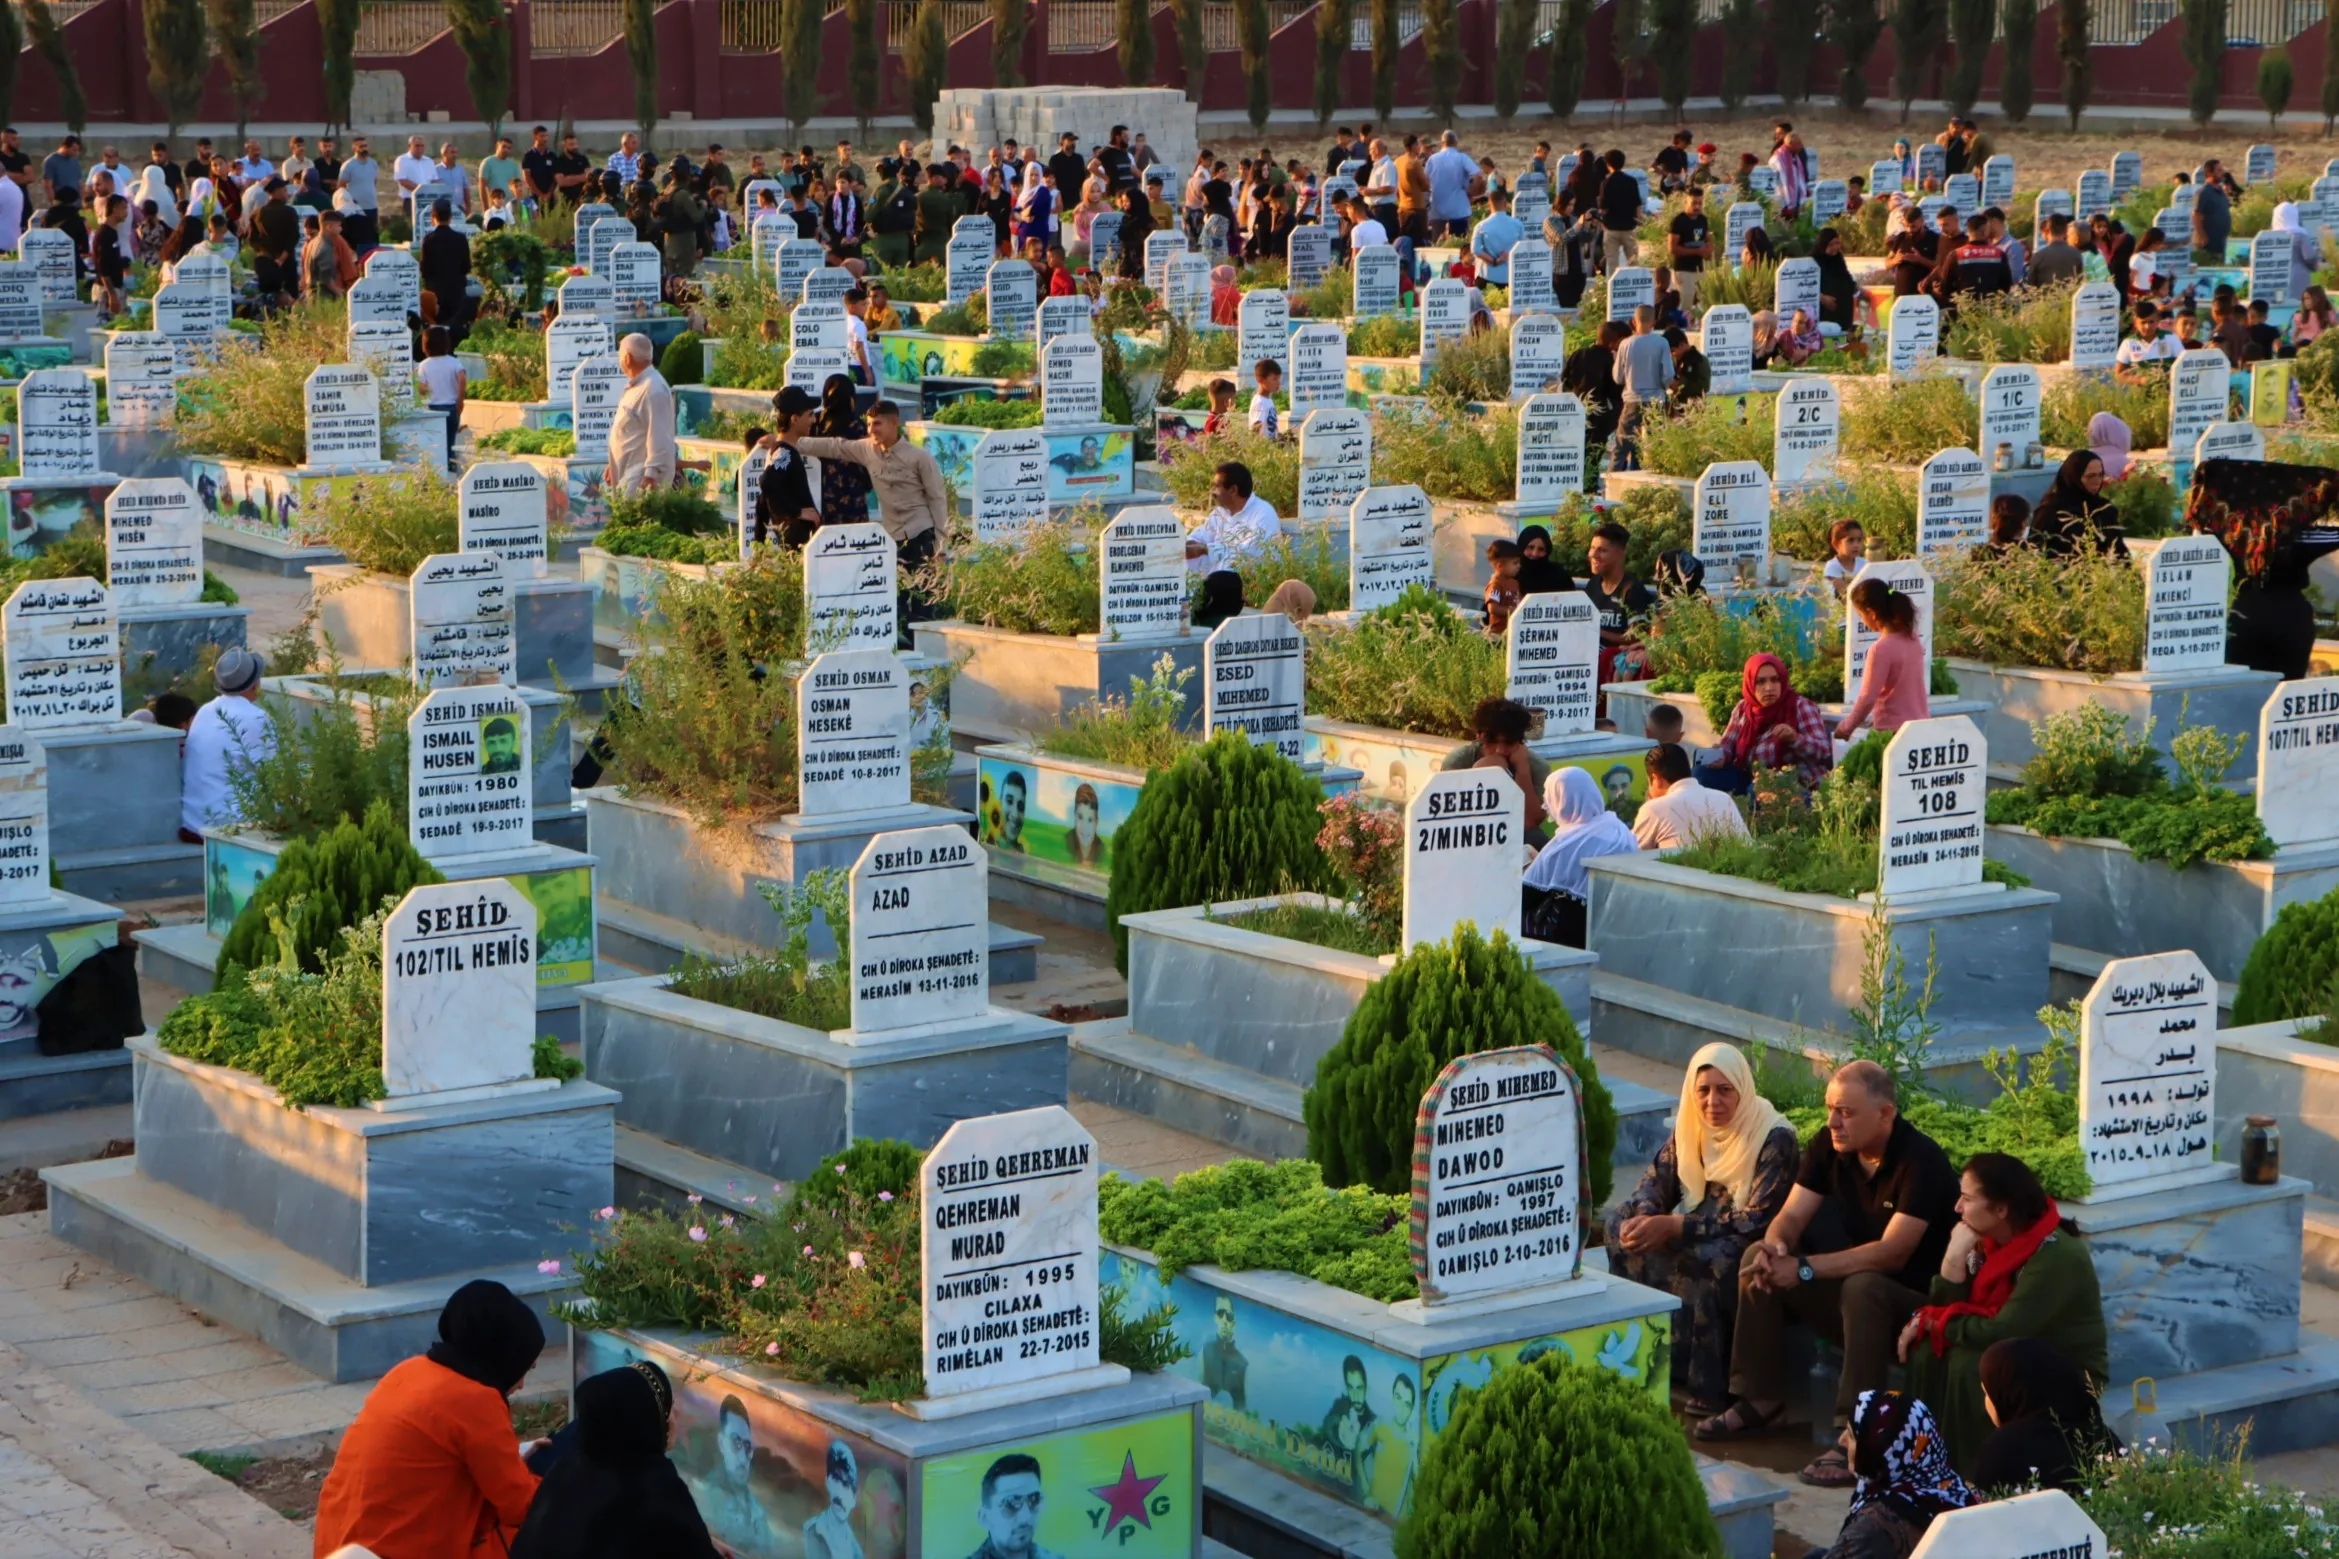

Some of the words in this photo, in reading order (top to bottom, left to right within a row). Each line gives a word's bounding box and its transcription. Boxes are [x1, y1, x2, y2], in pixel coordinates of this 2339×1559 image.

[2003, 391, 2022, 406] 1/C
[1798, 407, 1820, 422] 2/C
[1392, 496, 1423, 514] الشهيد
[1705, 509, 1728, 520] ZORE
[112, 516, 152, 528] MIHEMED
[850, 532, 885, 550] الشهيد
[458, 558, 498, 576] الشهيد
[73, 588, 104, 608] الشهيد
[1519, 647, 1557, 660] MIHEMED
[853, 670, 890, 685] OSMAN
[1216, 665, 1254, 682] ESED
[1557, 682, 1586, 691] 1994
[102, 695, 114, 712] تل
[811, 698, 850, 713] OSMAN
[1217, 688, 1269, 705] MIHEMED
[423, 731, 475, 748] ISMAIL
[423, 751, 475, 769] HUSEN
[1908, 738, 1969, 771] ŞEHÎD
[852, 766, 900, 780] 10-8-2017
[474, 776, 517, 792] 1980
[1911, 778, 1928, 790] TIL
[1429, 782, 1499, 818] ŞEHÎD
[1919, 790, 1956, 813] 108
[472, 817, 523, 833] 19-9-2017
[1419, 822, 1507, 852] 2/MINBIC
[929, 845, 967, 864] AZAD
[1935, 845, 1980, 862] 24-11-2016
[873, 887, 909, 912] AZAD
[417, 895, 508, 936] ŞEHÎD
[396, 946, 464, 977] 102/TIL
[861, 964, 877, 977] CIH
[919, 973, 978, 993] 13-11-2016
[2168, 973, 2204, 1002] الشهيد
[2146, 982, 2165, 1004] بلال
[2160, 1018, 2196, 1033] محمد
[1497, 1070, 1556, 1098] MIHEMED
[2108, 1090, 2153, 1108] ١٩٩٨
[1437, 1113, 1504, 1145] MIHEMED
[2145, 1114, 2174, 1136] تاريخ
[2184, 1110, 2207, 1130] مكان
[2177, 1136, 2206, 1157] هول
[996, 1144, 1089, 1178] QEHREMAN
[1438, 1148, 1503, 1181] DAWOD
[1507, 1174, 1563, 1199] QAMIŞLO
[1520, 1192, 1555, 1210] 1997
[936, 1194, 1020, 1230] QEHREMAN
[952, 1231, 1004, 1262] MURAD
[1436, 1230, 1455, 1248] CIH
[1438, 1249, 1498, 1278] QAMIŞLO
[1505, 1235, 1569, 1265] 2-10-2016
[1026, 1264, 1074, 1287] 1995
[985, 1294, 1042, 1318] CILAXA
[937, 1331, 956, 1350] CIH
[938, 1347, 1003, 1374] RIMÊLAN
[1020, 1331, 1090, 1360] 22-7-2015
